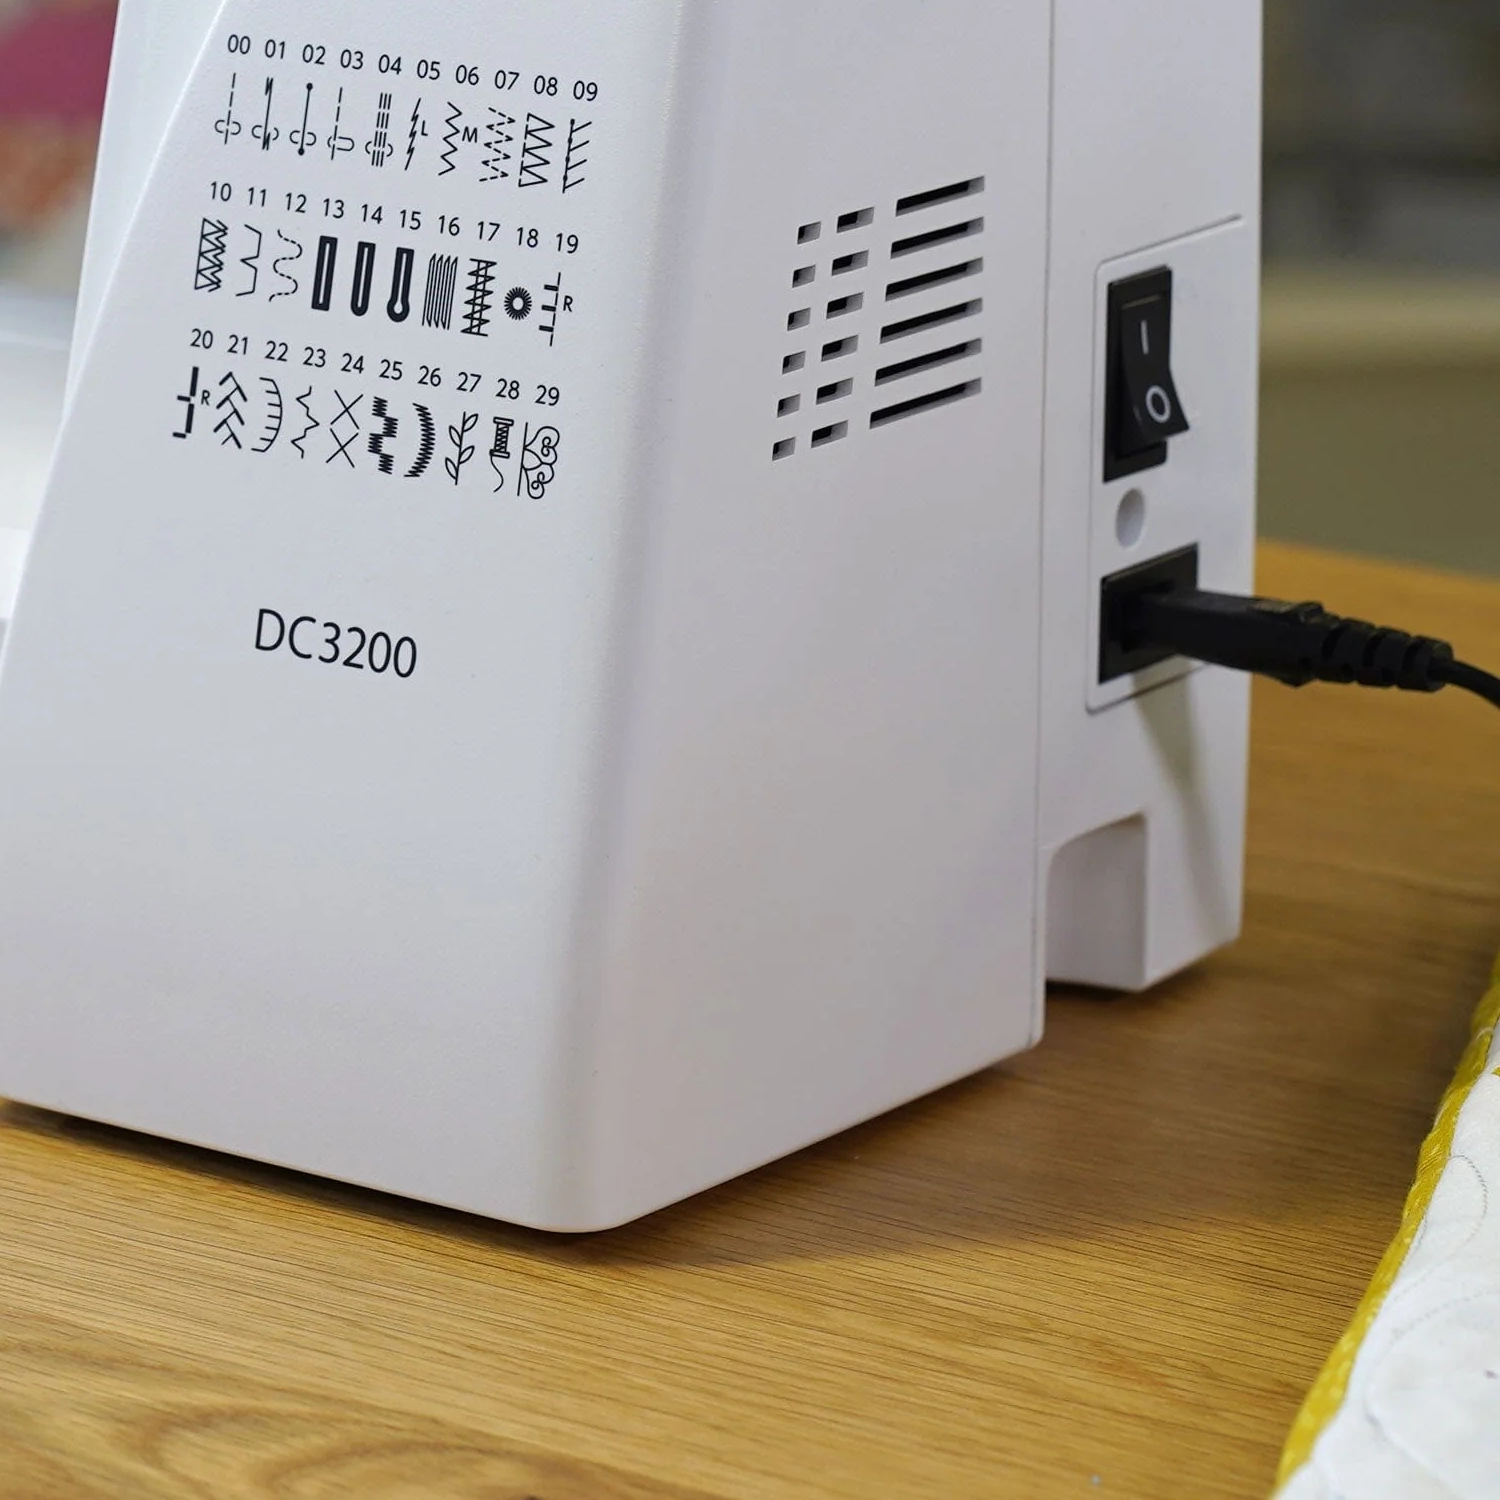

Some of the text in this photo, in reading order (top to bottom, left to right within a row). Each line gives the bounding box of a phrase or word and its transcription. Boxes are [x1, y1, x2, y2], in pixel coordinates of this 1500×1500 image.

[227, 34, 599, 102] 00 01 02 03 04 05 06 07 08 09
[420, 119, 429, 137] L
[461, 125, 478, 144] M
[210, 180, 579, 255] 10 11 12 13 14 15 16 17 18 19
[562, 294, 574, 313] R
[189, 327, 560, 407] 20 21 22 23 24 25 26 27 28 29
[200, 389, 211, 407] R
[255, 608, 418, 678] DC3200
